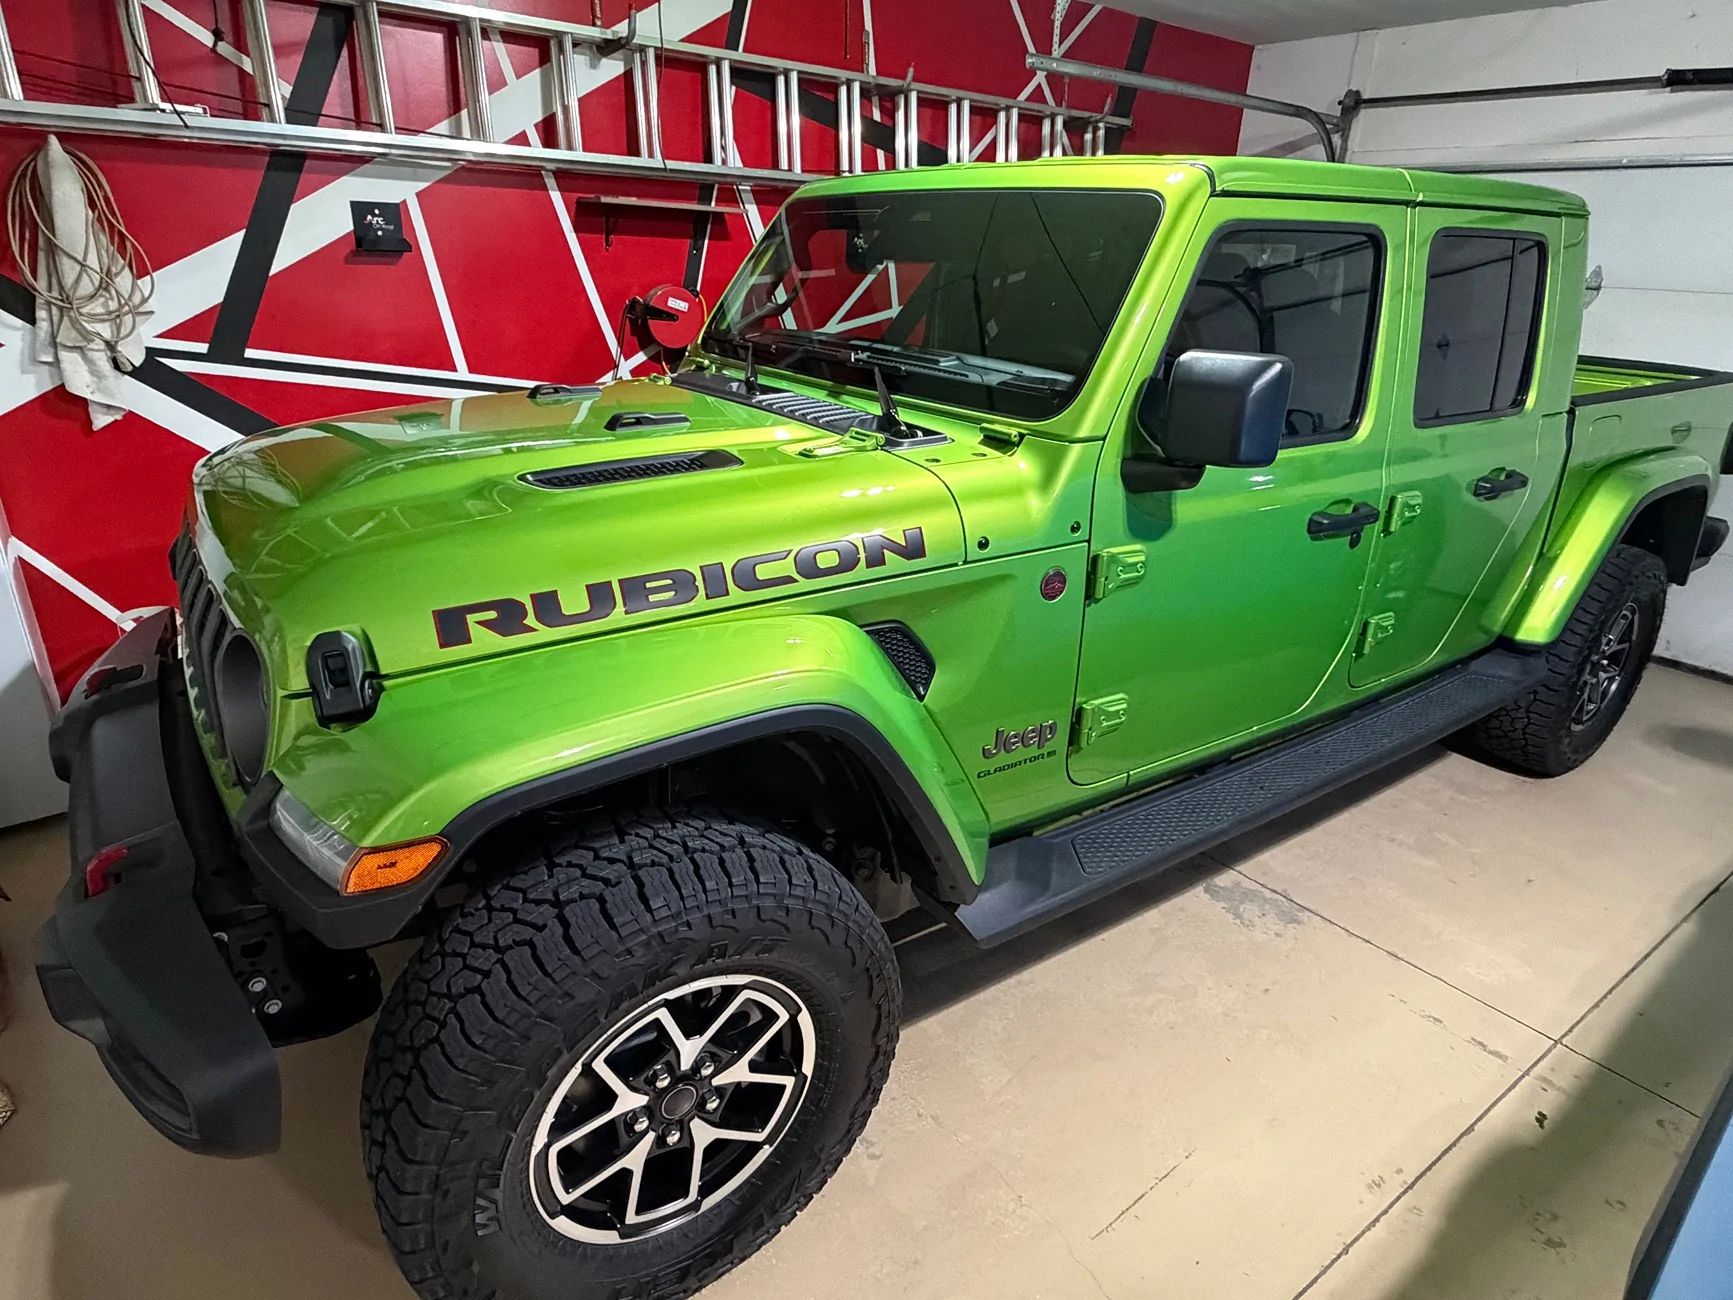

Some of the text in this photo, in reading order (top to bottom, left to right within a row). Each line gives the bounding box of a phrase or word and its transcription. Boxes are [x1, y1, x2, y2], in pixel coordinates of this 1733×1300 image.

[432, 526, 927, 650] RUBICON
[982, 720, 1058, 760] Jeep
[976, 752, 1046, 779] GLADIATOR
